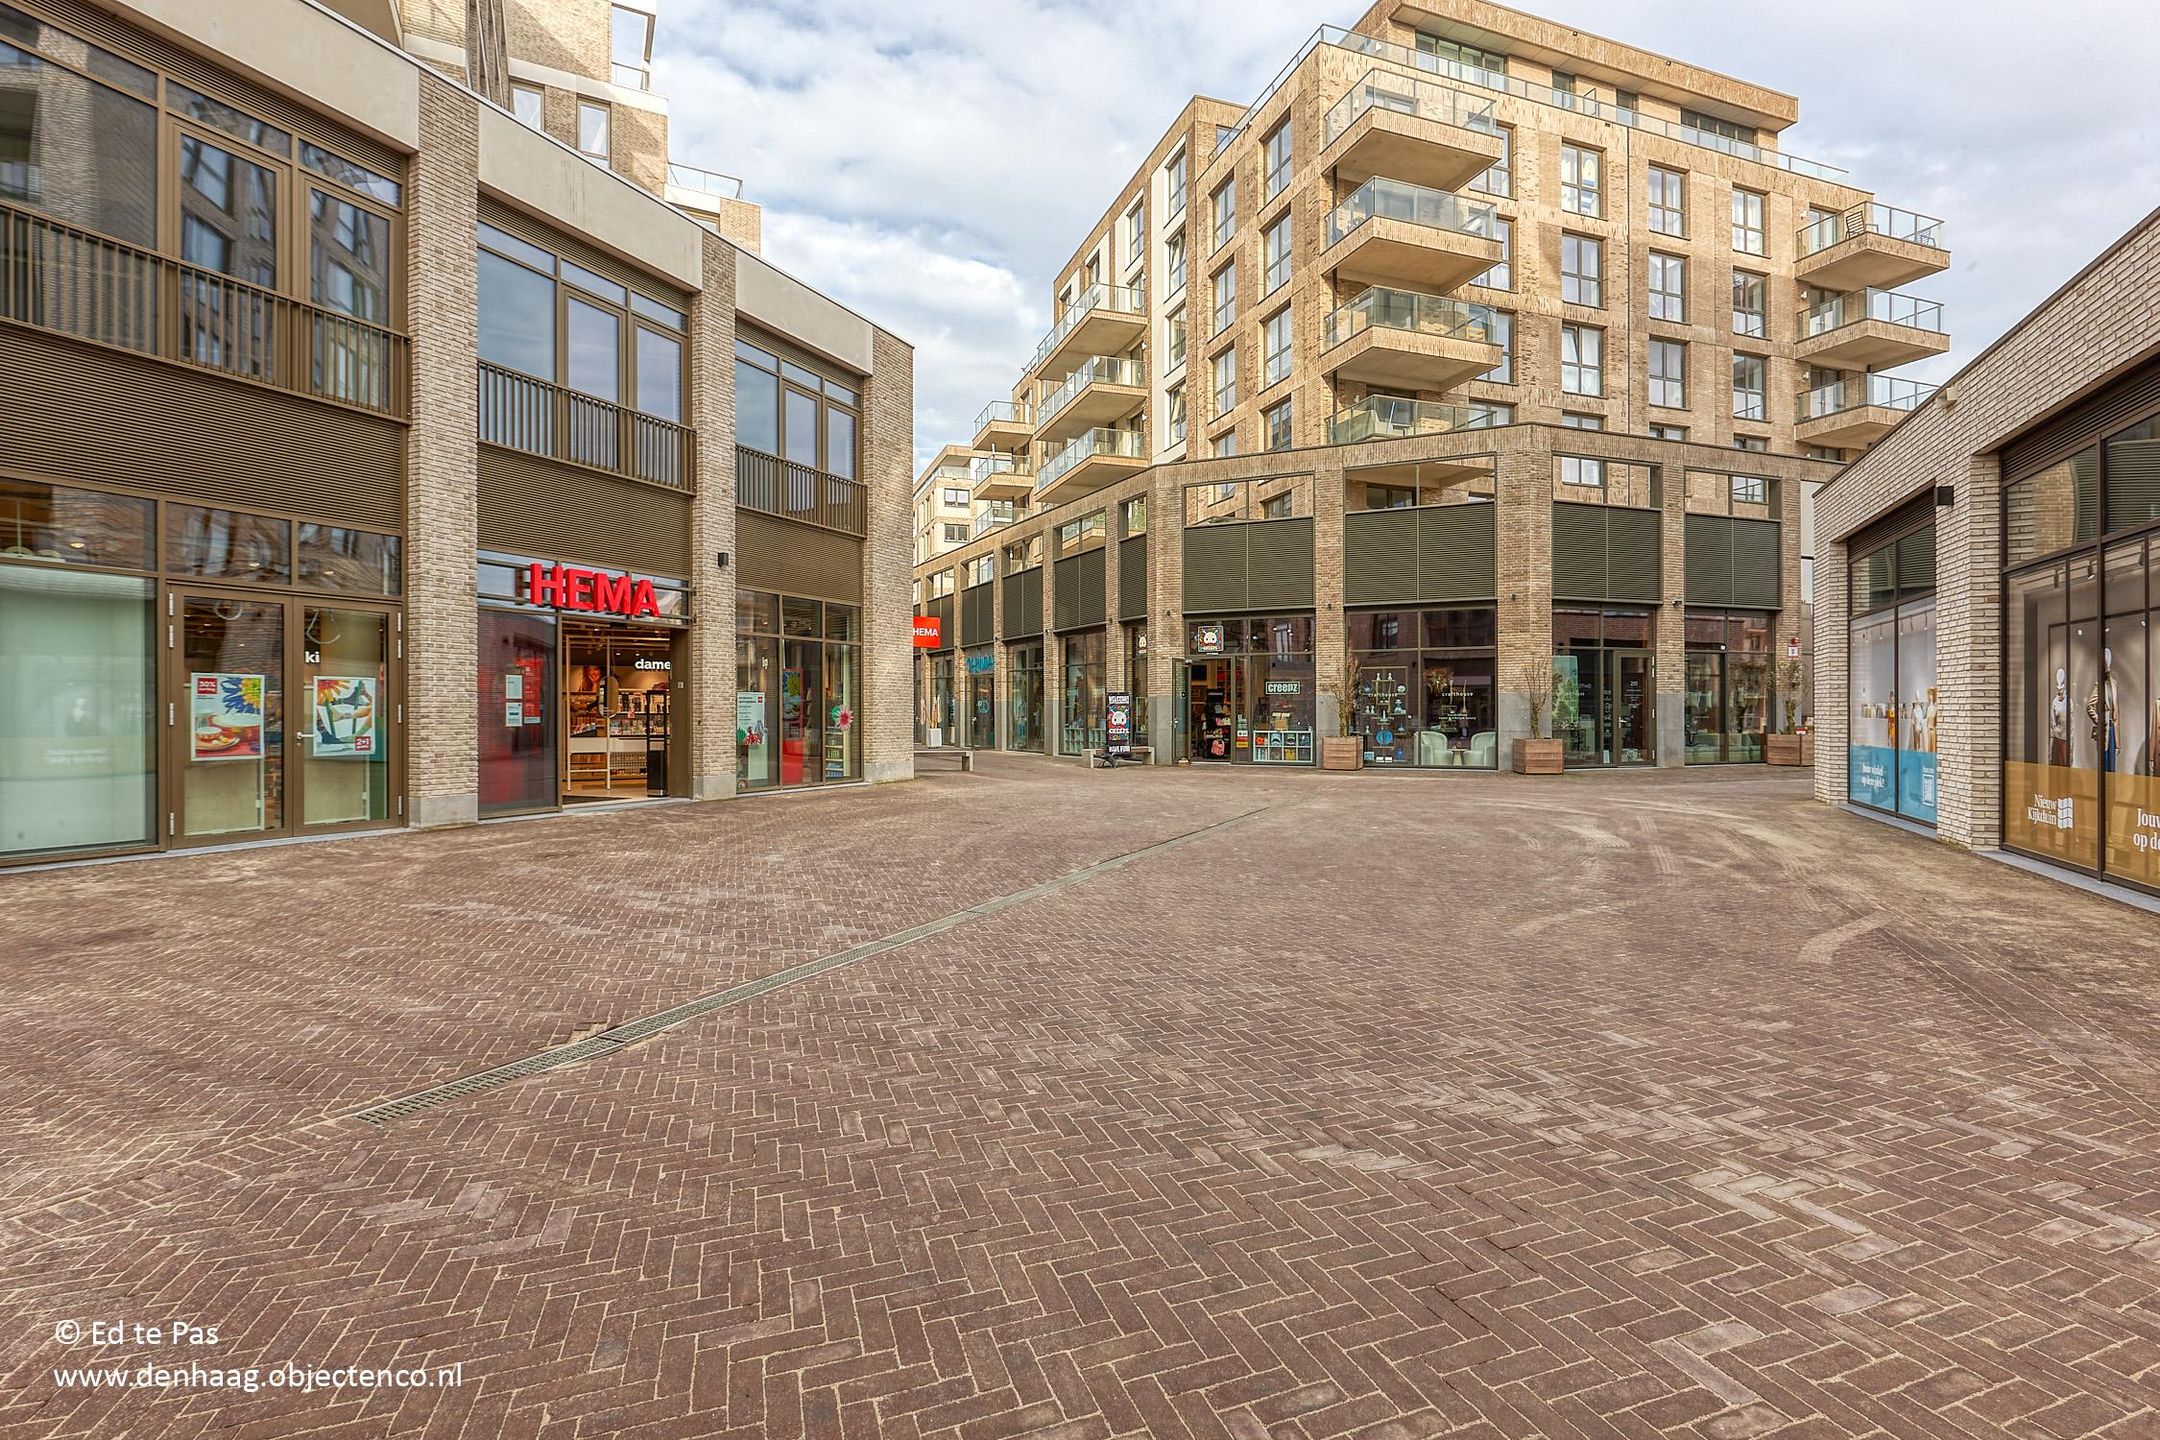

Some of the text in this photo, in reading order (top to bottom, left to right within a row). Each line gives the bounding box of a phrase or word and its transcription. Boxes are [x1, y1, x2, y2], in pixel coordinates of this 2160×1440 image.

[530, 563, 660, 617] HEMA
[913, 627, 939, 637] HEMA
[305, 651, 320, 663] ki
[635, 658, 671, 670] dame
[1267, 683, 1298, 693] creepz
[2034, 794, 2058, 810] Nieuw
[2027, 806, 2057, 826] Kijkduin
[2133, 833, 2148, 852] op
